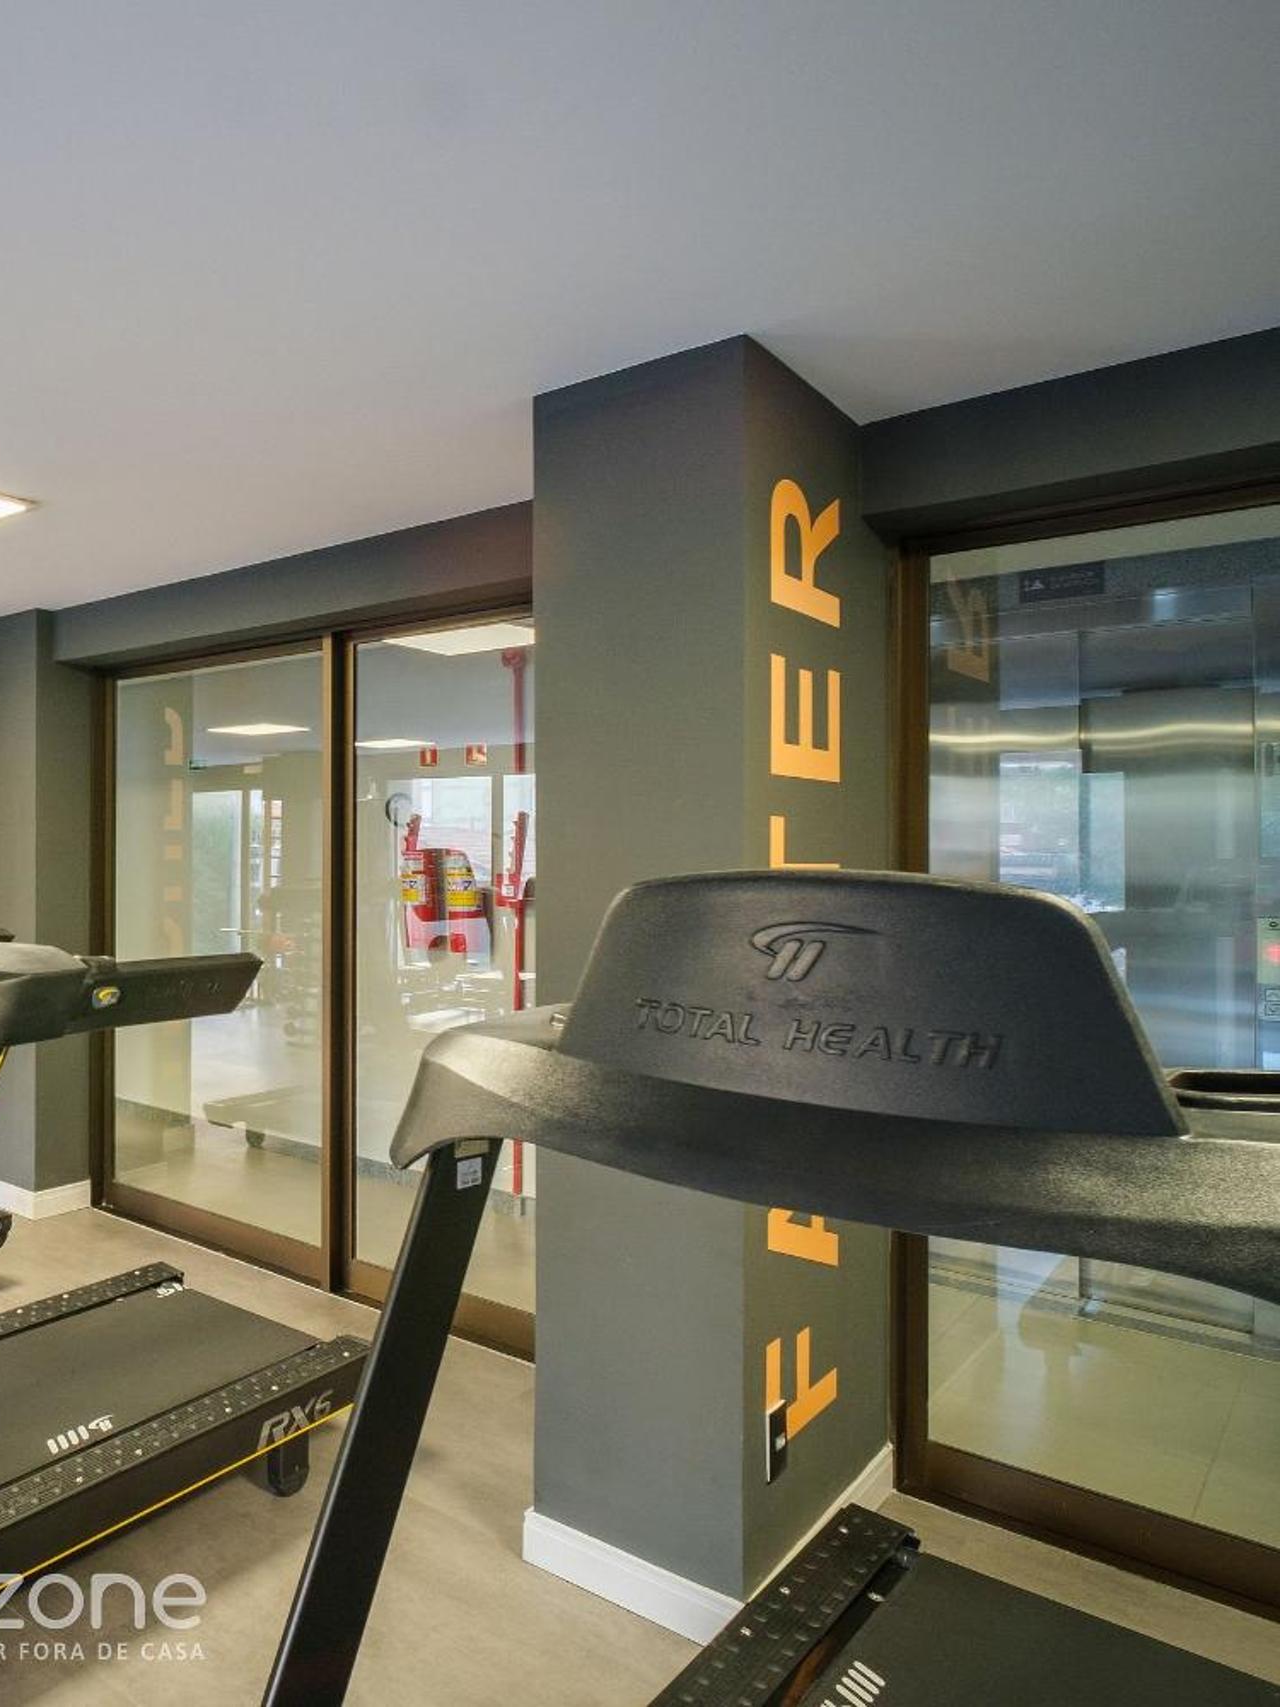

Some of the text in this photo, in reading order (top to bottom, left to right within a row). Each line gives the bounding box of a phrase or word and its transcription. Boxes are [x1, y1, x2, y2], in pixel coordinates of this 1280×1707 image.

[767, 478, 841, 1440] FER
[636, 998, 1004, 1071] TOTAL HEALTH
[257, 1389, 333, 1450] RX6
